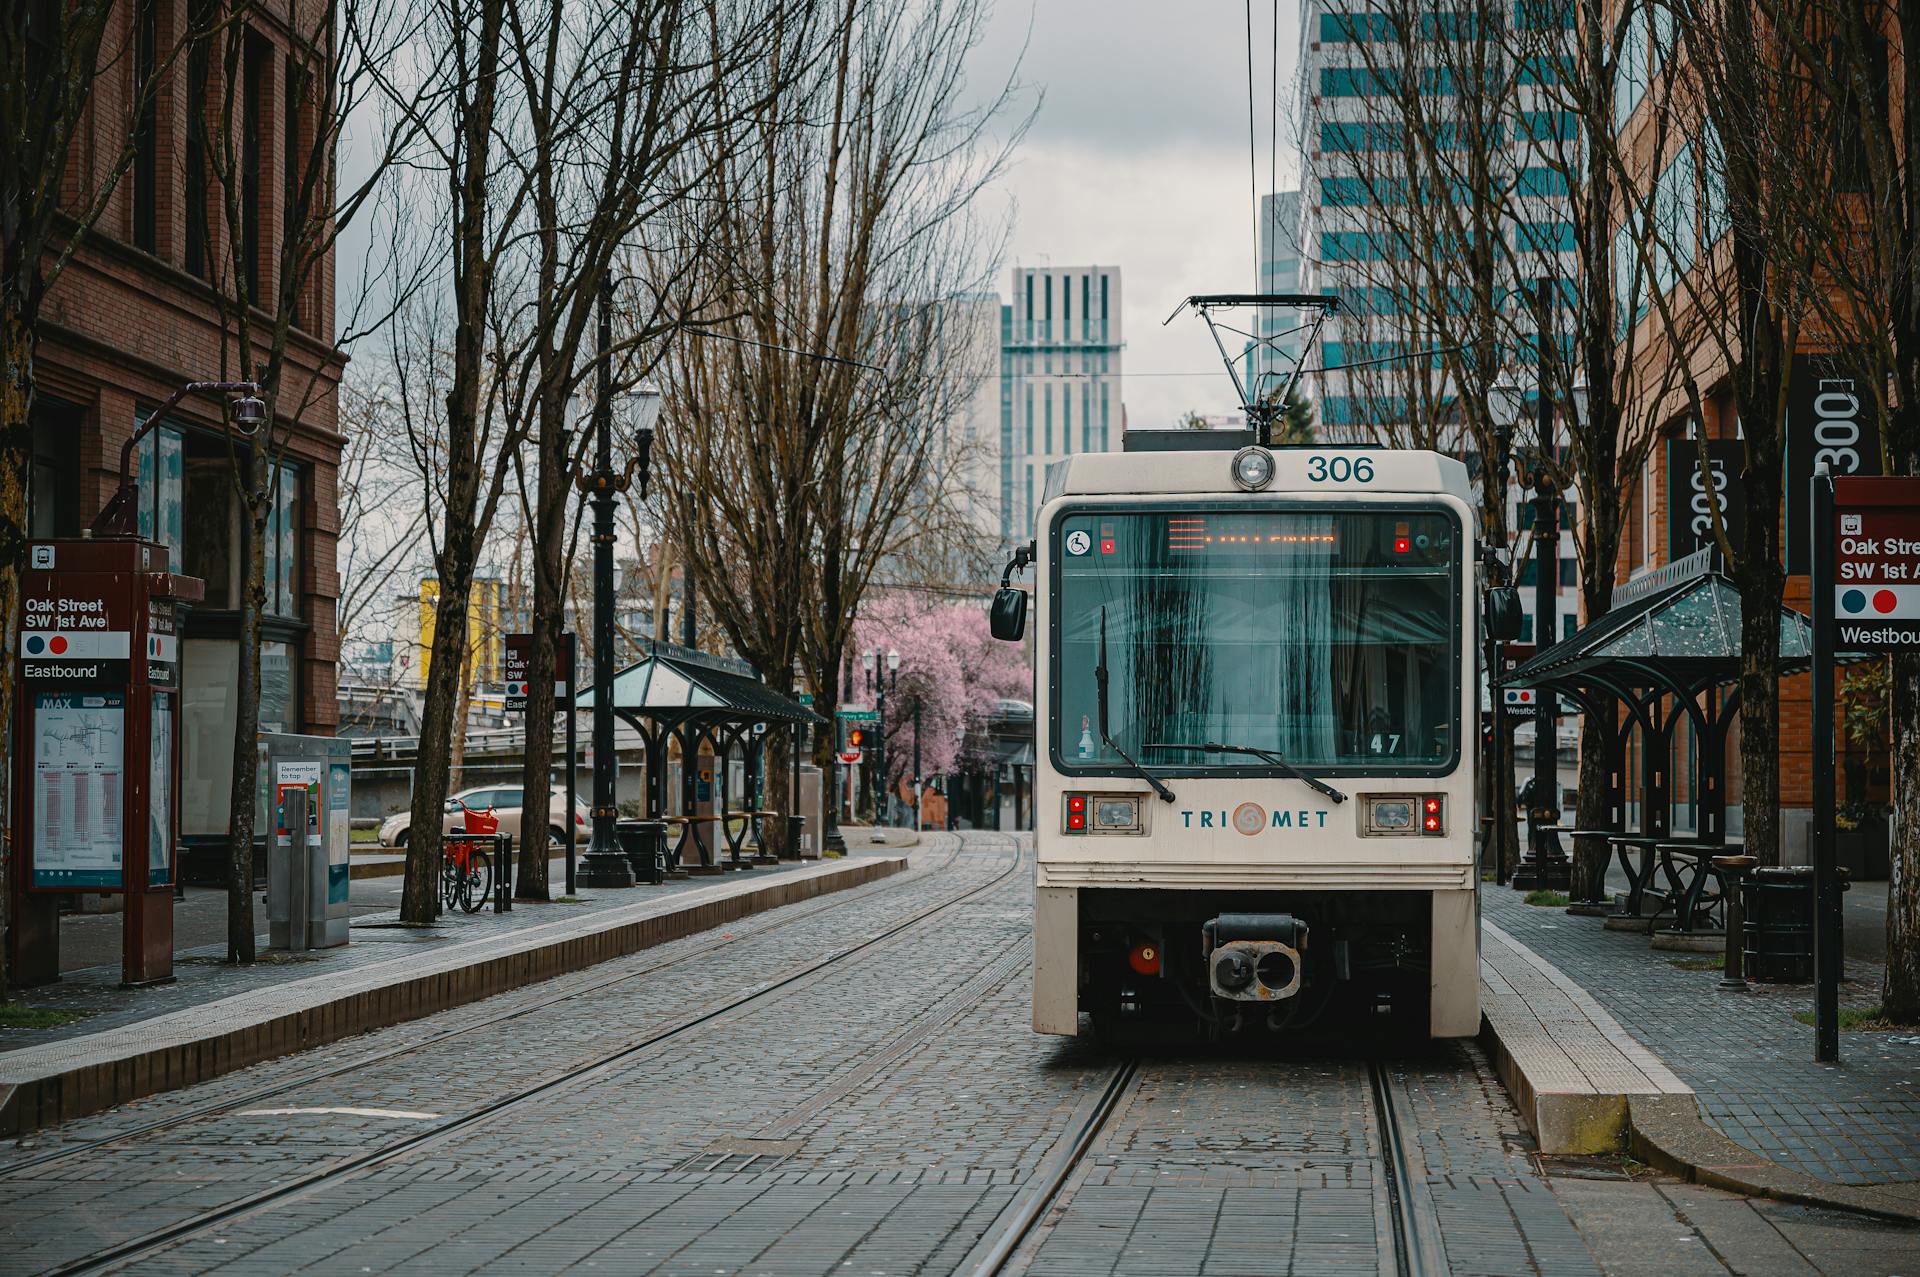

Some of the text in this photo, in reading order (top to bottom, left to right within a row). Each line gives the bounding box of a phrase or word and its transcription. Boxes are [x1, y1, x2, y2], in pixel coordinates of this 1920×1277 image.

[1307, 456, 1375, 483] 306
[1840, 538, 1880, 555] Oak
[1840, 562, 1875, 580] SW
[1880, 562, 1908, 580] 1st
[26, 598, 103, 612] Oak Street
[26, 615, 106, 628] SW 1st Ave
[24, 664, 97, 678] Eastbound
[507, 660, 525, 668] Oak
[42, 698, 72, 709] MAX
[506, 700, 527, 708] East
[1370, 734, 1400, 754] 47
[1181, 810, 1328, 828] TRI MET
